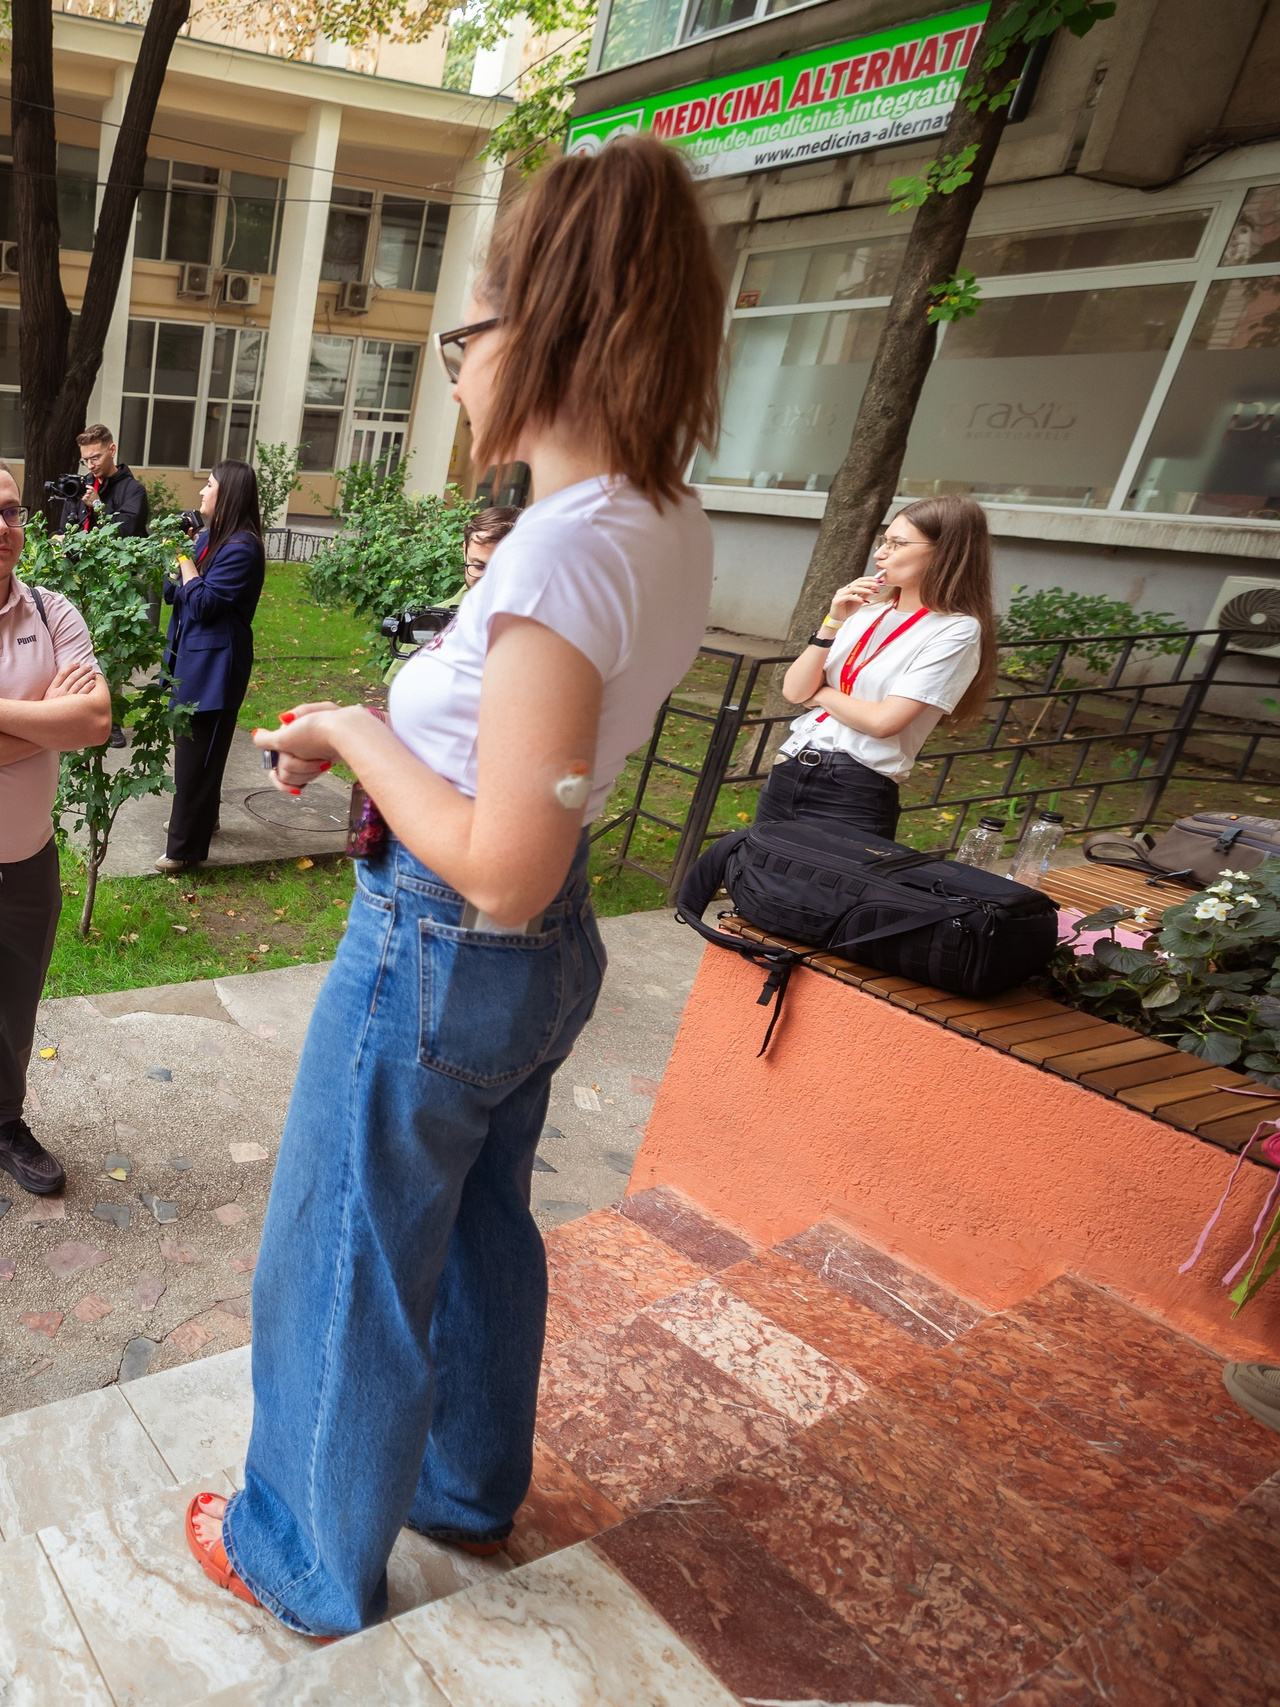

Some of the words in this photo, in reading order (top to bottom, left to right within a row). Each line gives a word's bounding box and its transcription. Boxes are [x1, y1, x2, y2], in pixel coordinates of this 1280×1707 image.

[651, 78, 782, 141] MEDICINA
[789, 22, 985, 109] ALTERNATI
[723, 129, 746, 151] de
[750, 102, 845, 146] medicină
